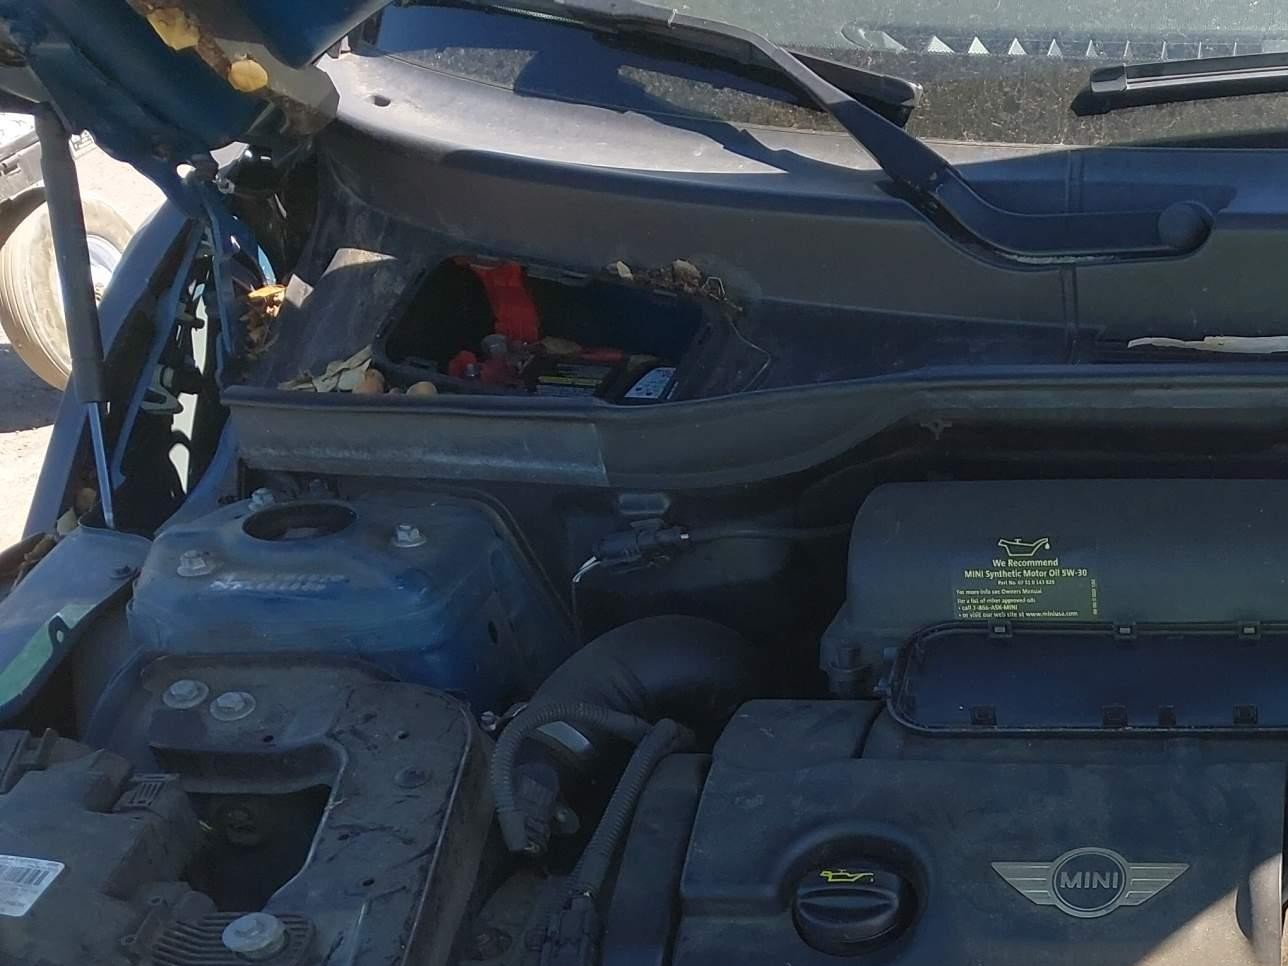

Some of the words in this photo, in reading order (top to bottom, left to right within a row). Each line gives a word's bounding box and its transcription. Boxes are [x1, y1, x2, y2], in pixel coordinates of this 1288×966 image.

[1008, 558, 1058, 567] Recommend
[964, 570, 984, 578] MINI
[986, 570, 1022, 580] Synthetic
[1049, 569, 1060, 577] Oil
[1062, 569, 1088, 577] 5W-30
[1060, 872, 1118, 888] MINI
